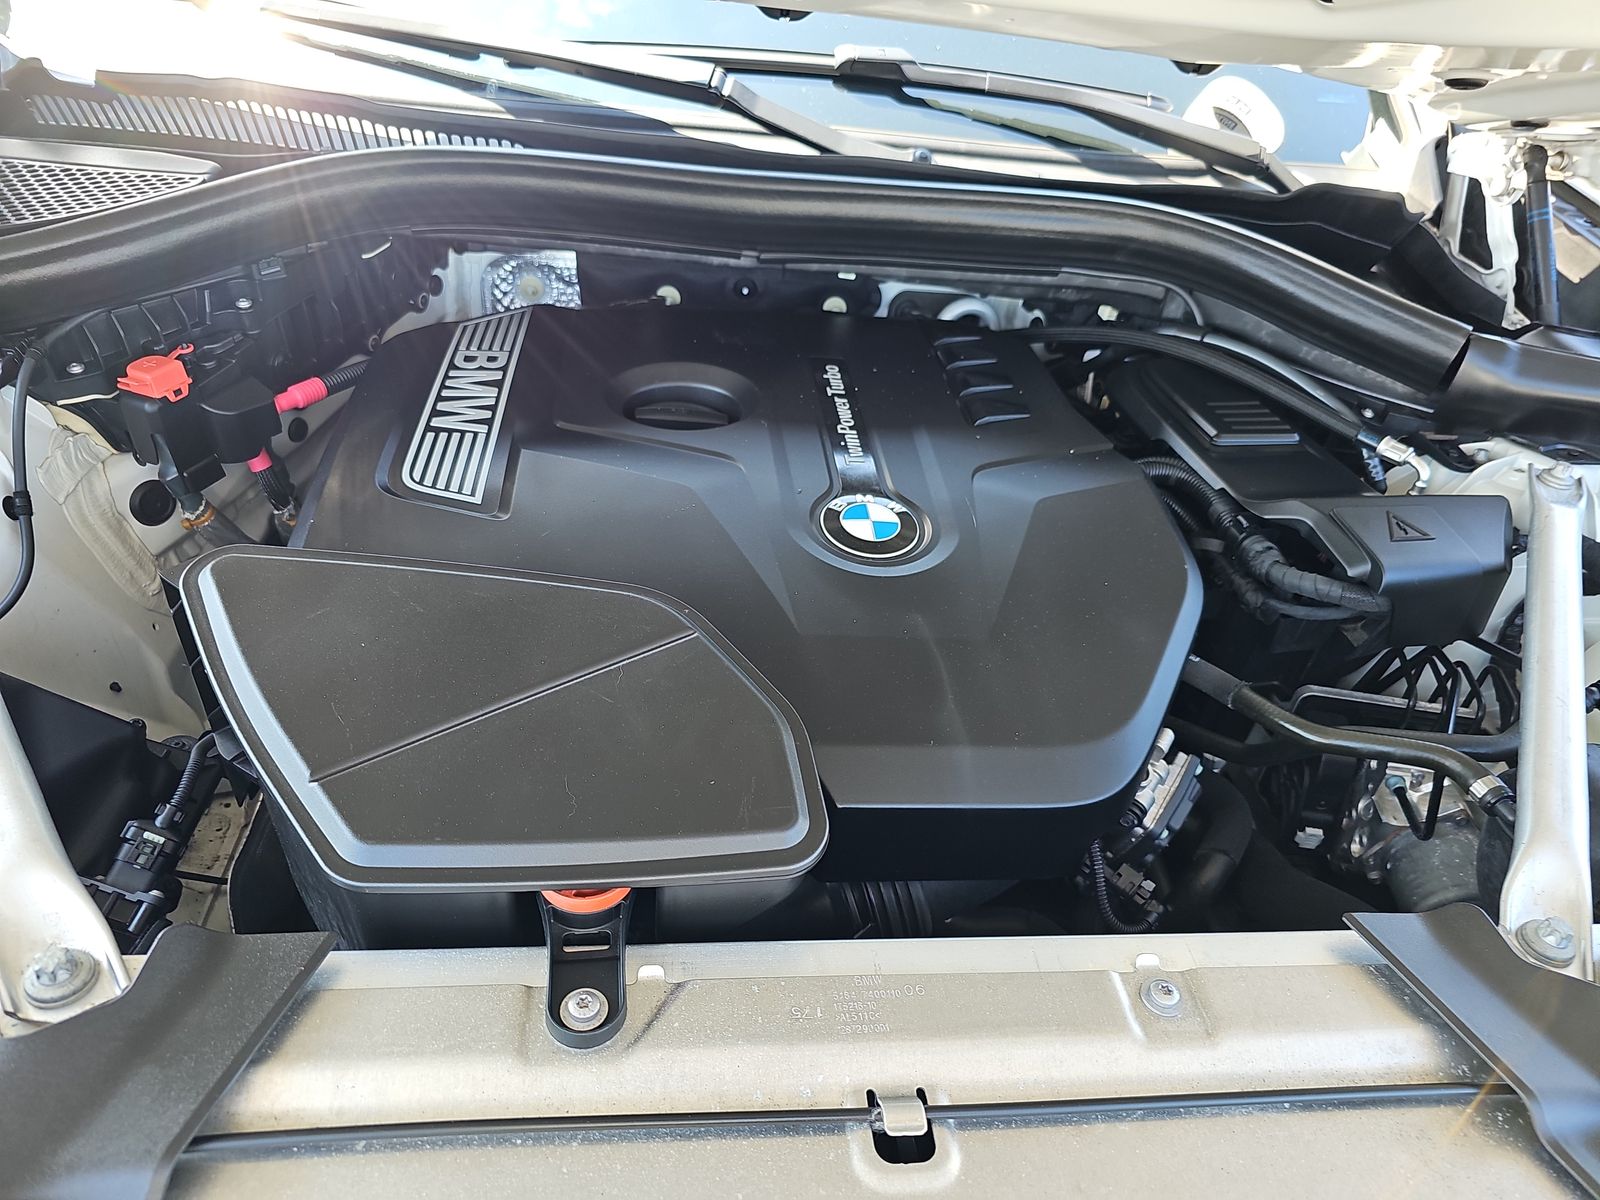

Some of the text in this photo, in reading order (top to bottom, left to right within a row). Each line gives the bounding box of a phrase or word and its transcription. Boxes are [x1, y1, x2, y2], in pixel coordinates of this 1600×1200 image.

[429, 350, 511, 433] BMW
[823, 364, 865, 465] TwinPower Turbo
[828, 494, 907, 513] BMW
[854, 975, 882, 986] BMW
